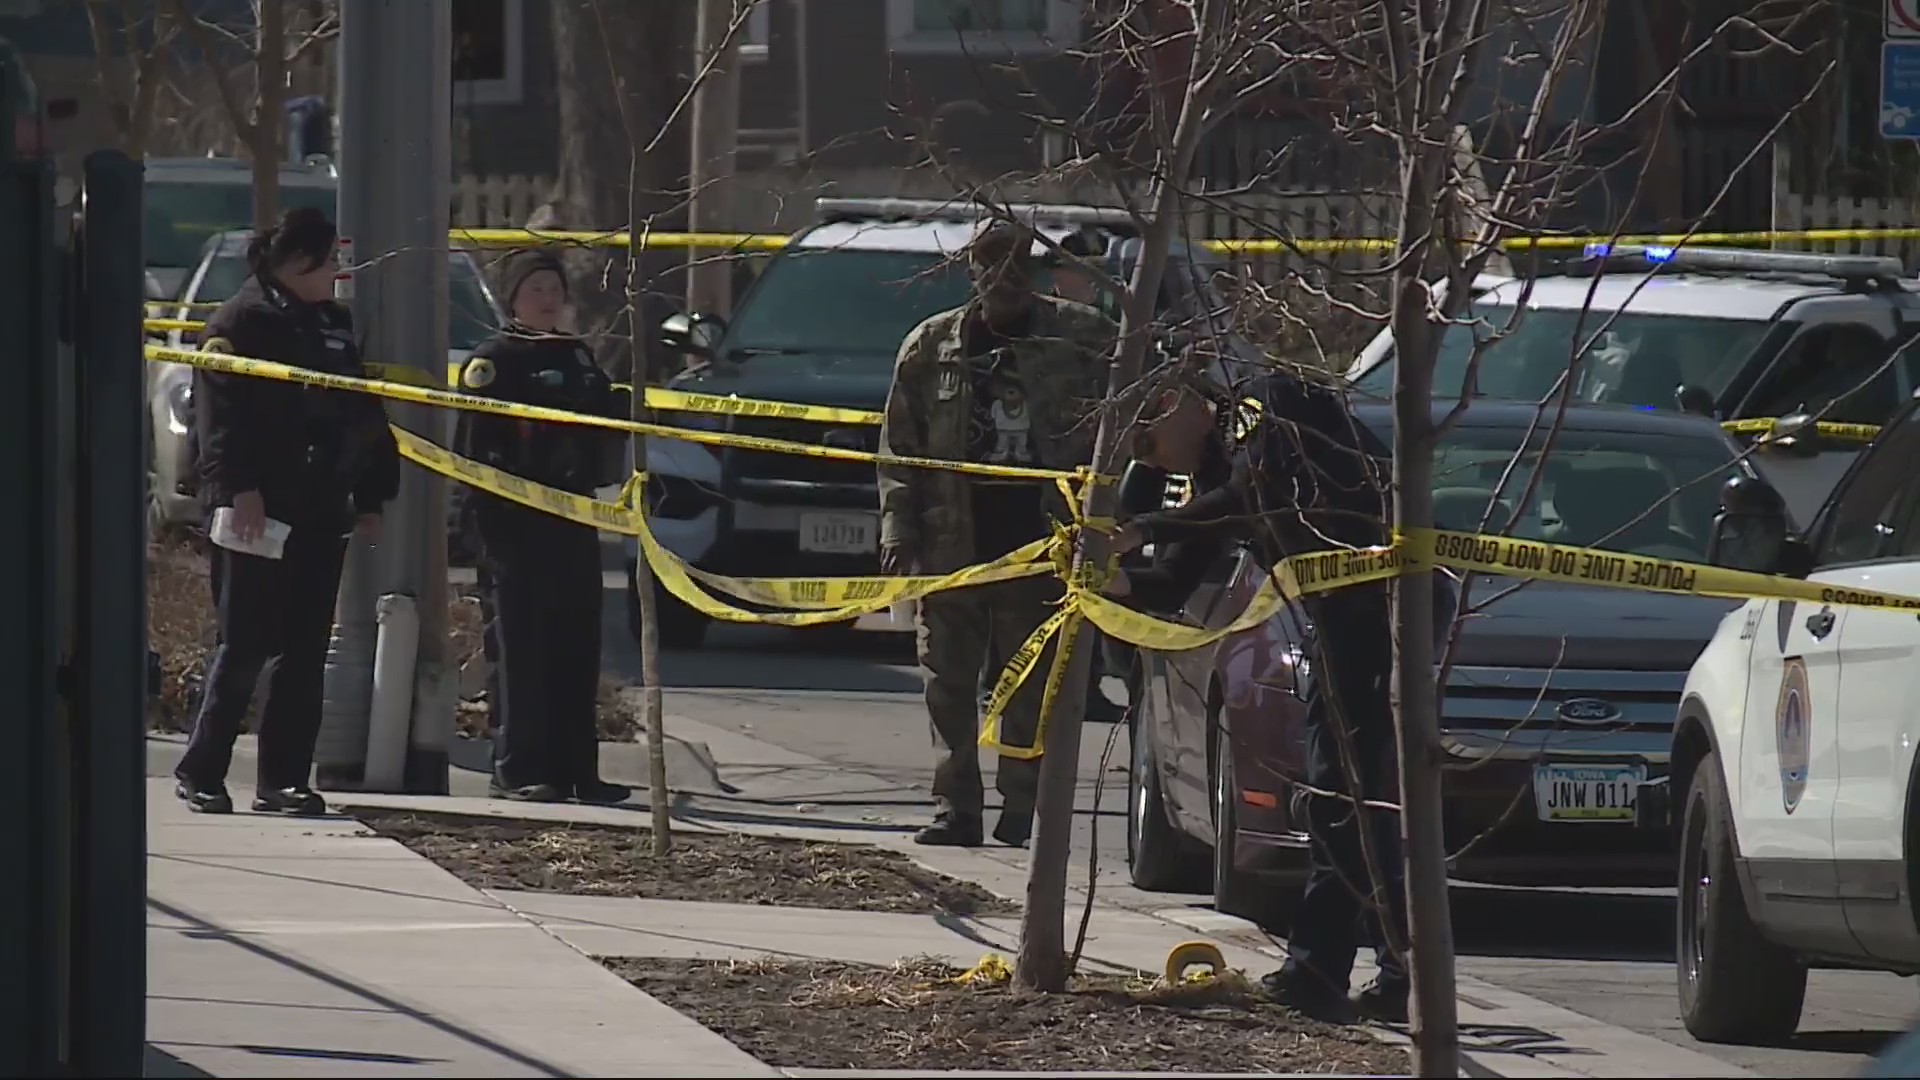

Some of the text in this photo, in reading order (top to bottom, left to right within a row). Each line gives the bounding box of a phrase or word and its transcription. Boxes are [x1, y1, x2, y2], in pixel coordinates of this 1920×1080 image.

[1290, 557, 1316, 586] NO
[1320, 555, 1339, 580] DO
[1434, 533, 1697, 591] POLICE LINE DO NOT CROSS
[1571, 703, 1607, 717] Ford
[1547, 781, 1633, 809] JNW 011
